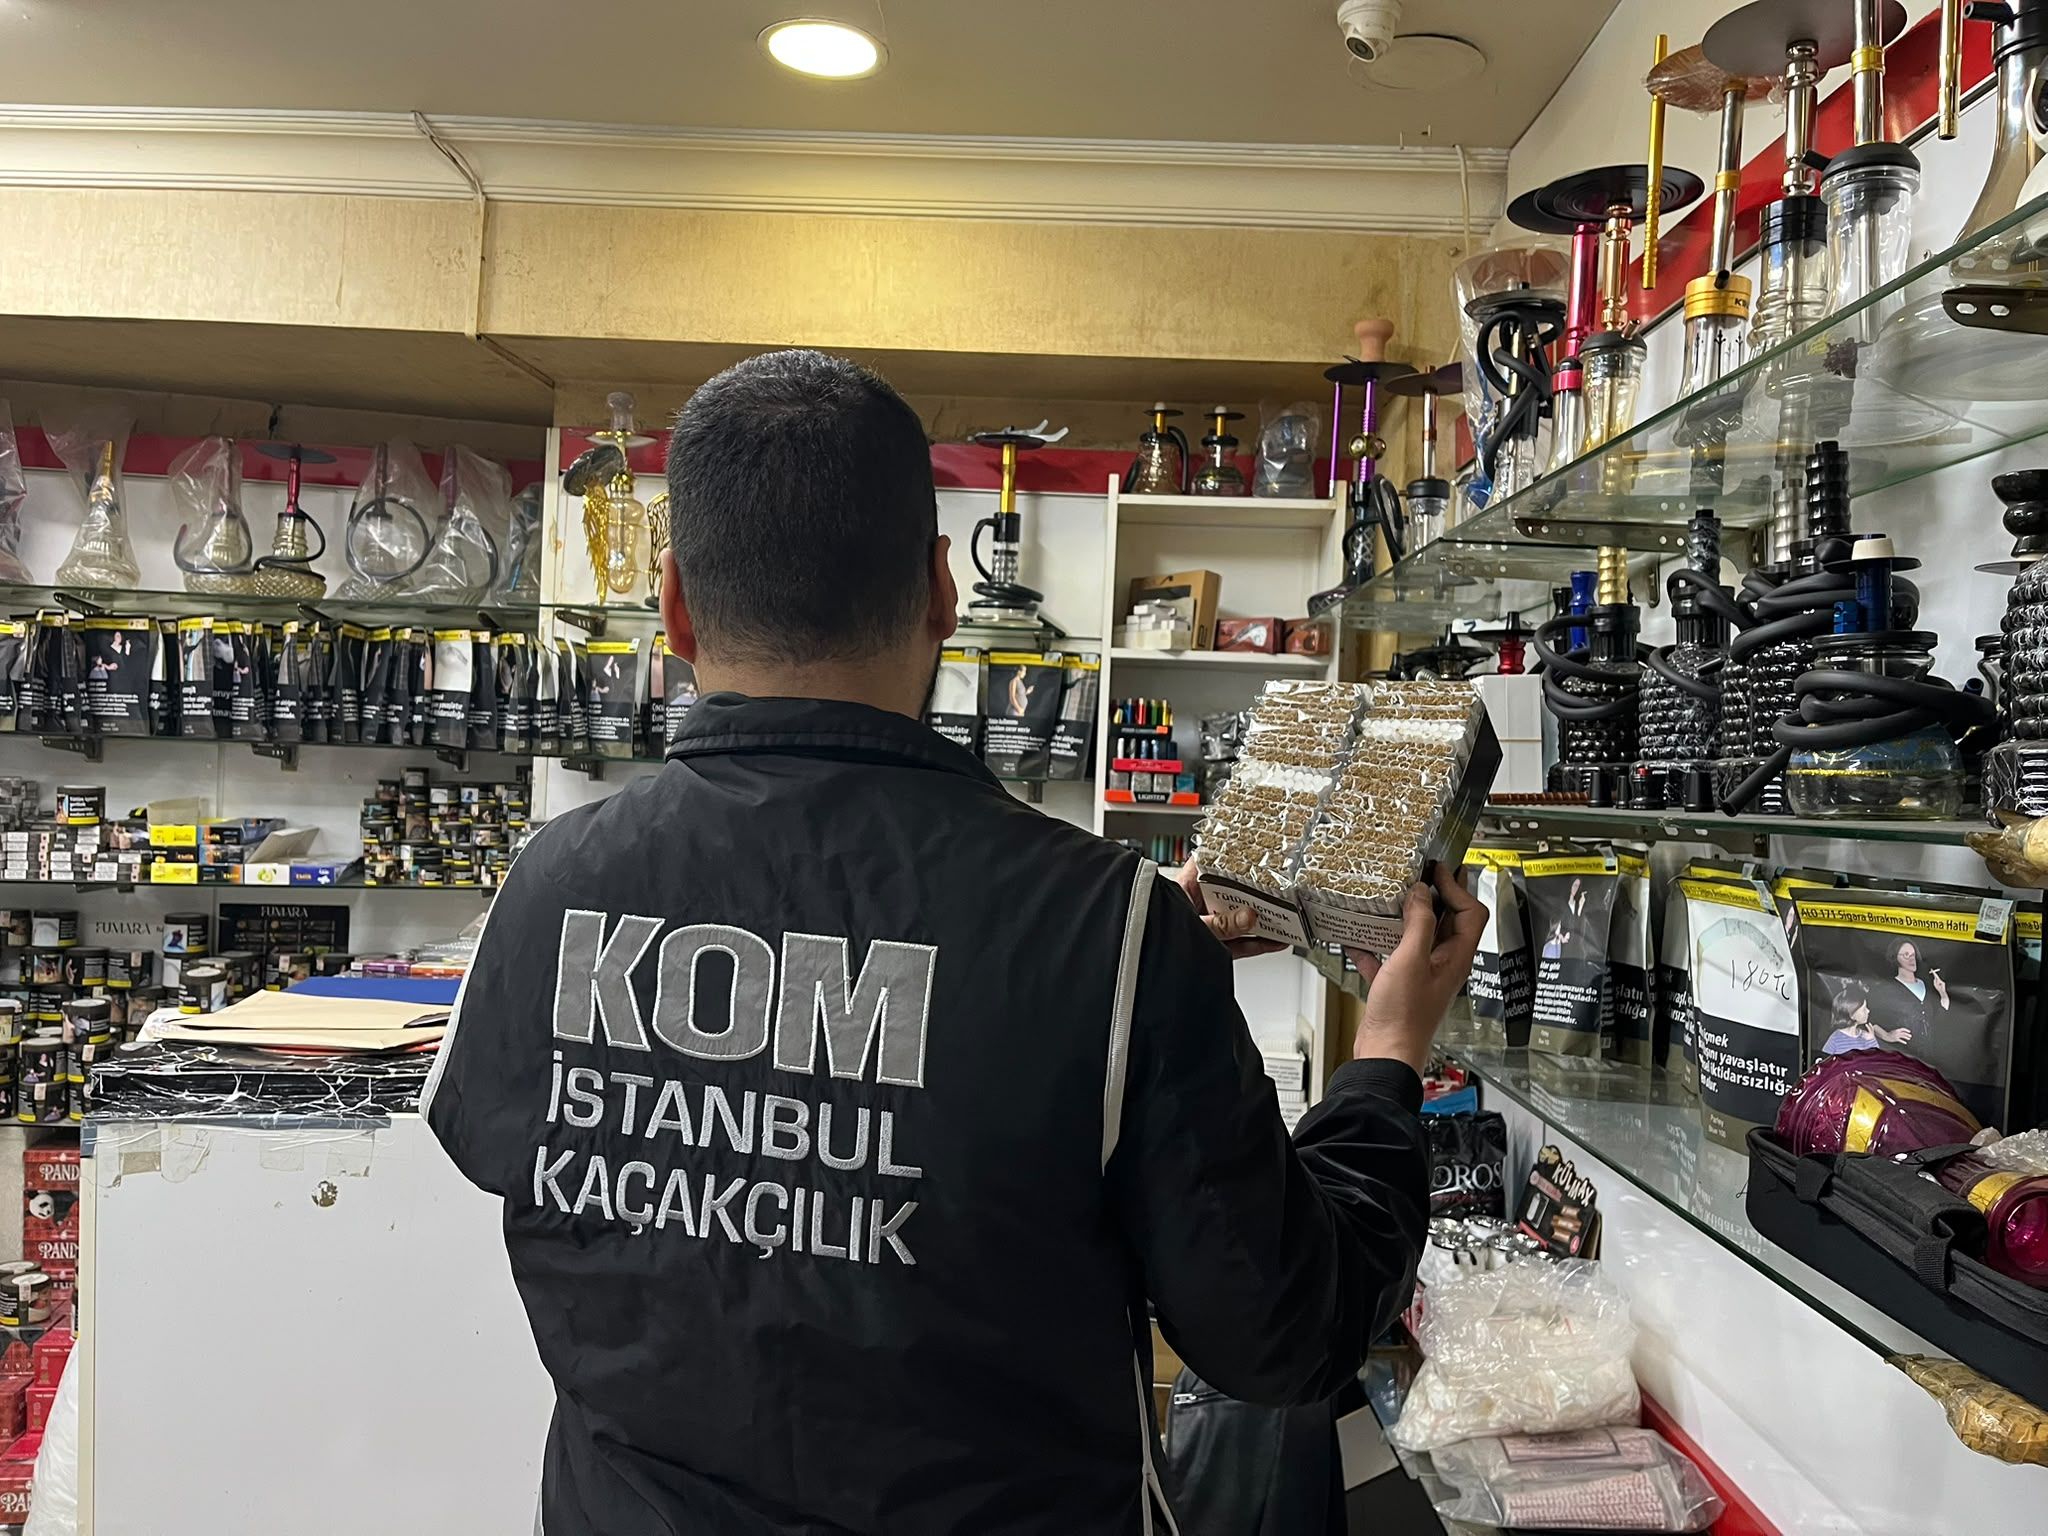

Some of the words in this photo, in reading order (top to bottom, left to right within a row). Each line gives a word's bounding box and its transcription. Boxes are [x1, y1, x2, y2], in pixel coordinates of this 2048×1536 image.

[261, 906, 309, 918] FUMARA
[1212, 891, 1250, 907] Tütün
[1253, 902, 1290, 922] içmek
[96, 921, 151, 935] FUMARA
[1801, 908, 1818, 917] ALO
[1820, 909, 1837, 919] 171
[1838, 910, 1867, 923] Sigara
[1868, 912, 1904, 926] Bırakma
[1905, 915, 1945, 931] Danışma
[1946, 919, 1969, 932] Hattı
[552, 908, 938, 1089] KOM
[1719, 1052, 1789, 1078] yavaşlatır
[546, 1050, 922, 1179] İSTANBUL
[39, 1163, 80, 1181] PAND
[534, 1145, 919, 1266] KAÇAKÇILIK
[38, 1241, 79, 1259] PAND
